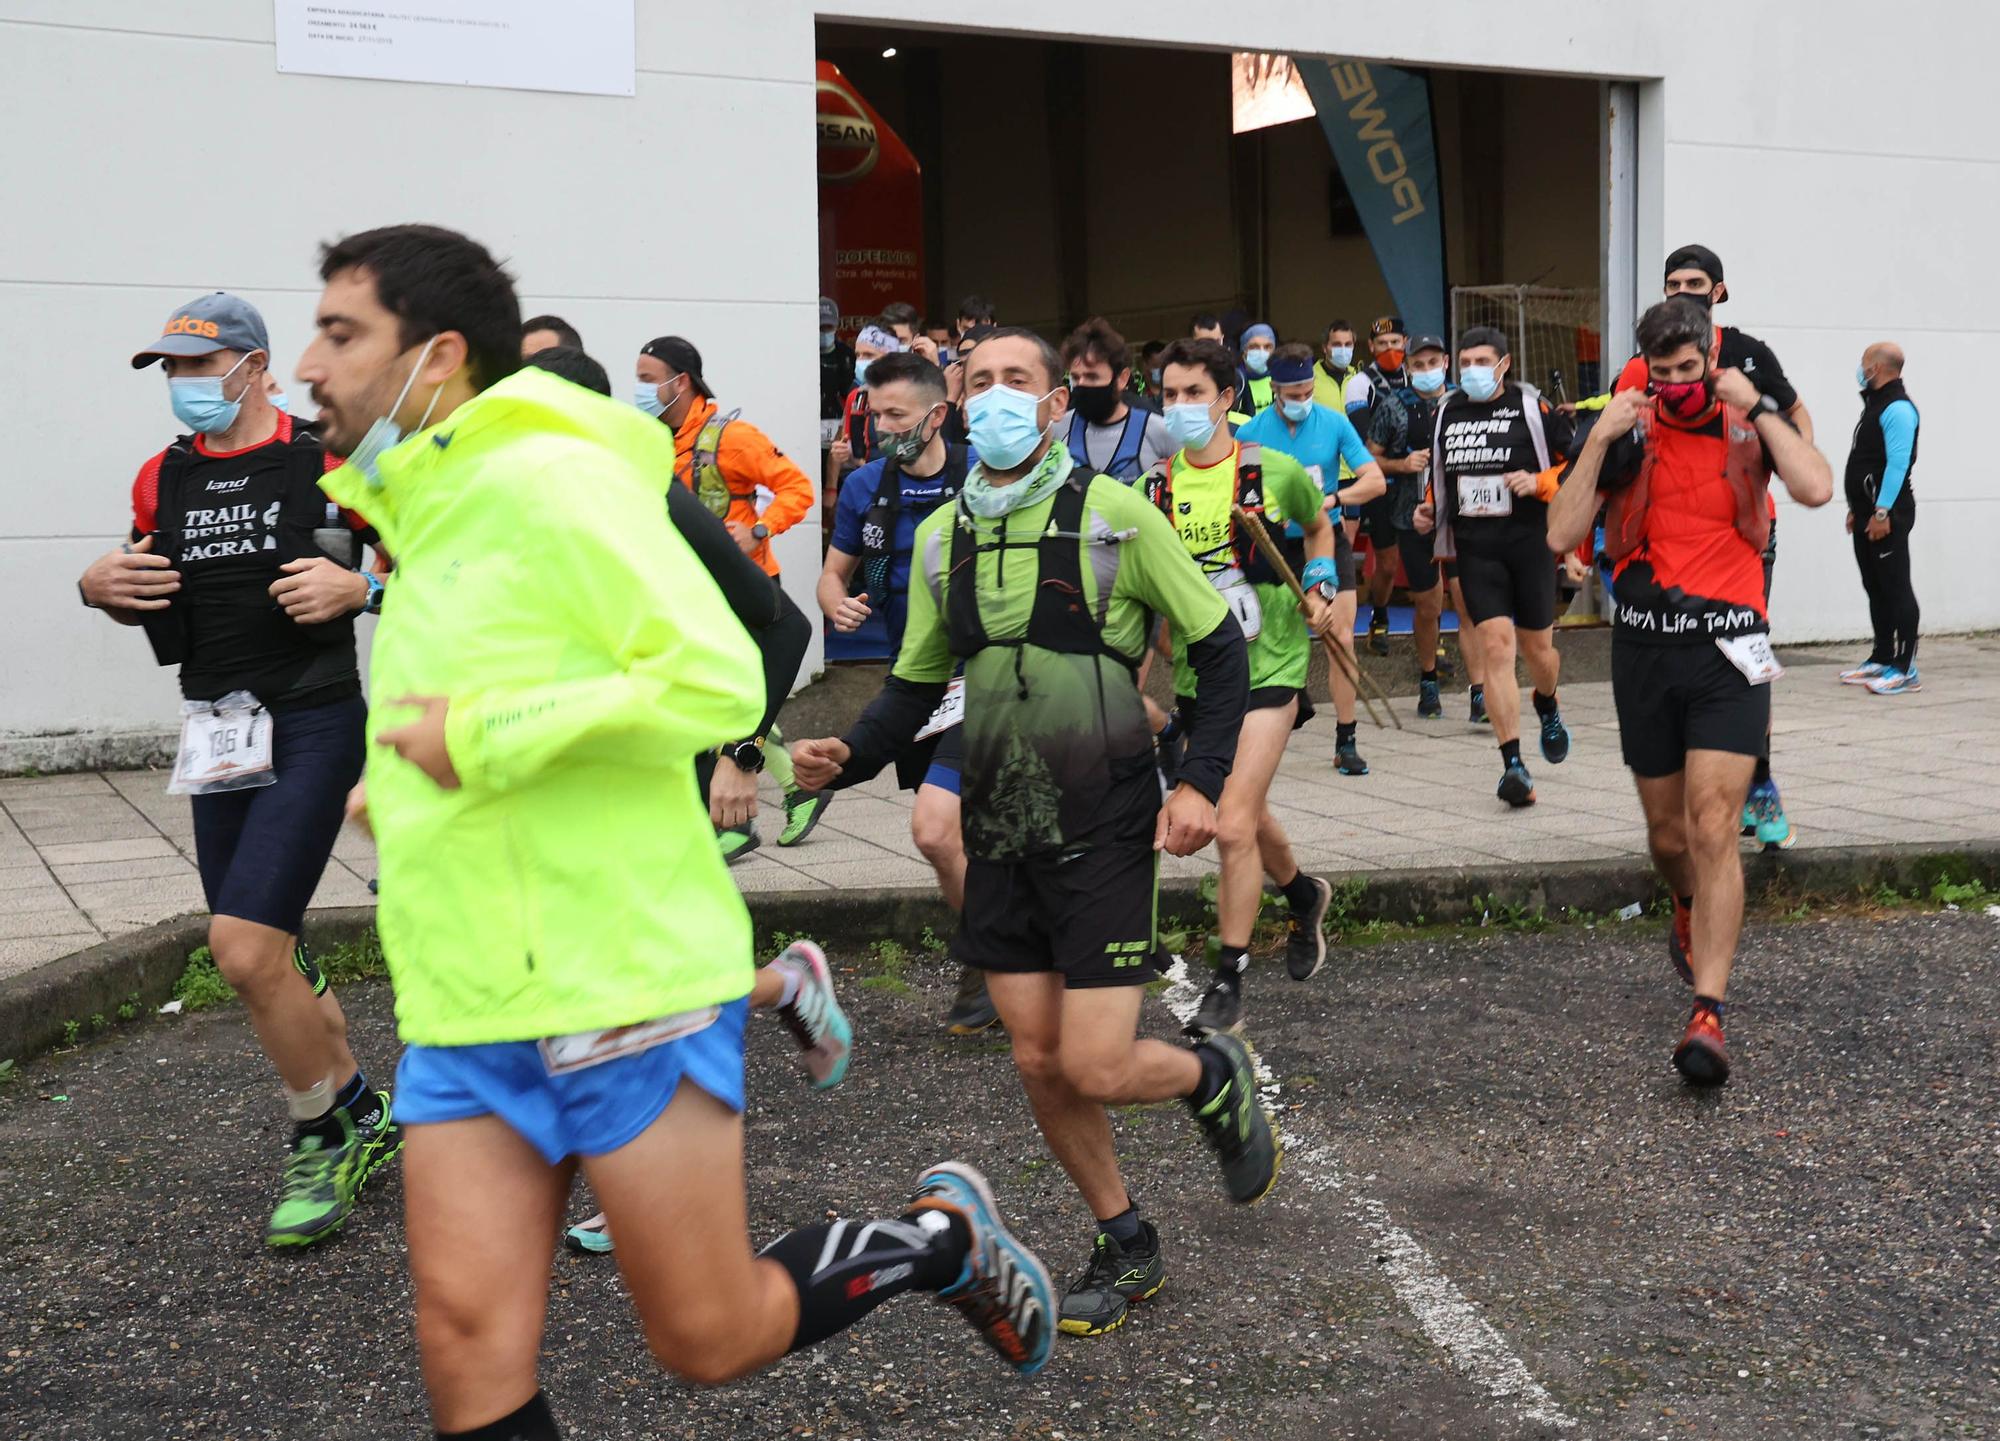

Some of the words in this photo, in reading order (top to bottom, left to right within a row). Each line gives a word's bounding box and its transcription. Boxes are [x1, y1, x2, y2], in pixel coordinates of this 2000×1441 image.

[1445, 433, 1487, 450] CARA
[205, 476, 250, 491] land
[185, 503, 257, 527] TRAIL
[1661, 612, 1698, 633] Life
[209, 728, 239, 758] 136
